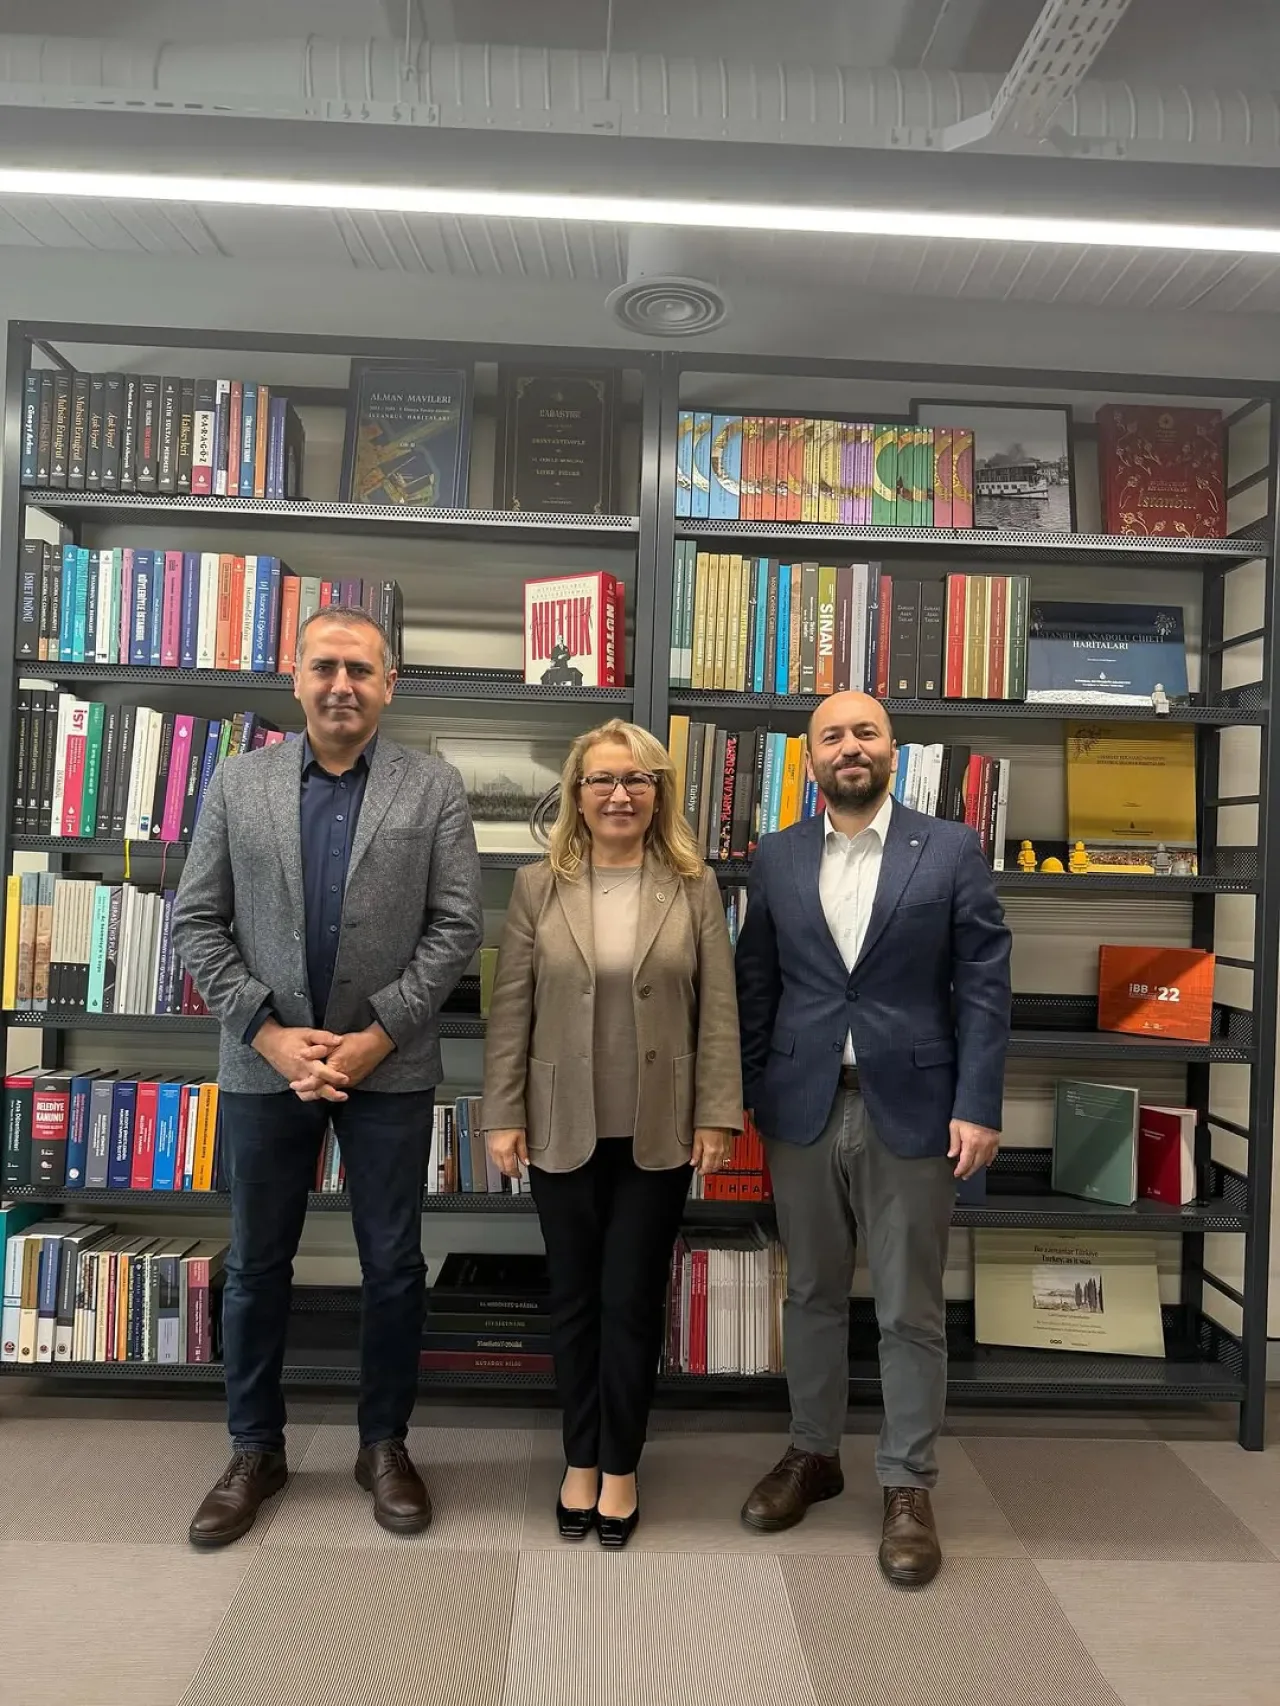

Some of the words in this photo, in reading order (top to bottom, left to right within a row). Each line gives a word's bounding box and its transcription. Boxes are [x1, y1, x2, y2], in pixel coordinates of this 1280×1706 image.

[57, 394, 67, 423] Muhsin
[75, 394, 85, 424] Muhsin
[370, 393, 403, 402] ALMAN
[407, 394, 452, 404] MAVİLERİ
[25, 404, 35, 430] Cüneyt
[25, 432, 35, 455] Arkın
[55, 424, 66, 458] Ertuğrul
[72, 425, 83, 460] Ertuğrul
[164, 419, 172, 444] SULTAN
[180, 414, 191, 456] Halkevleri
[163, 446, 171, 473] MEHMED
[136, 573, 148, 610] KÖYLERİYLE
[259, 593, 269, 619] İstanbul
[135, 611, 147, 642] İSTANBUL
[257, 620, 267, 650] Eğleniyor
[531, 596, 592, 661] NUTUK
[606, 603, 615, 671] NUTUK
[1087, 632, 1132, 643] ANADOLU
[1072, 640, 1129, 650] HARİTALARI
[688, 784, 699, 812] Türkiye
[35, 1102, 65, 1112] BELEDİYE
[35, 1112, 65, 1122] KANUNU
[13, 1113, 22, 1152] Düzenlemeleri
